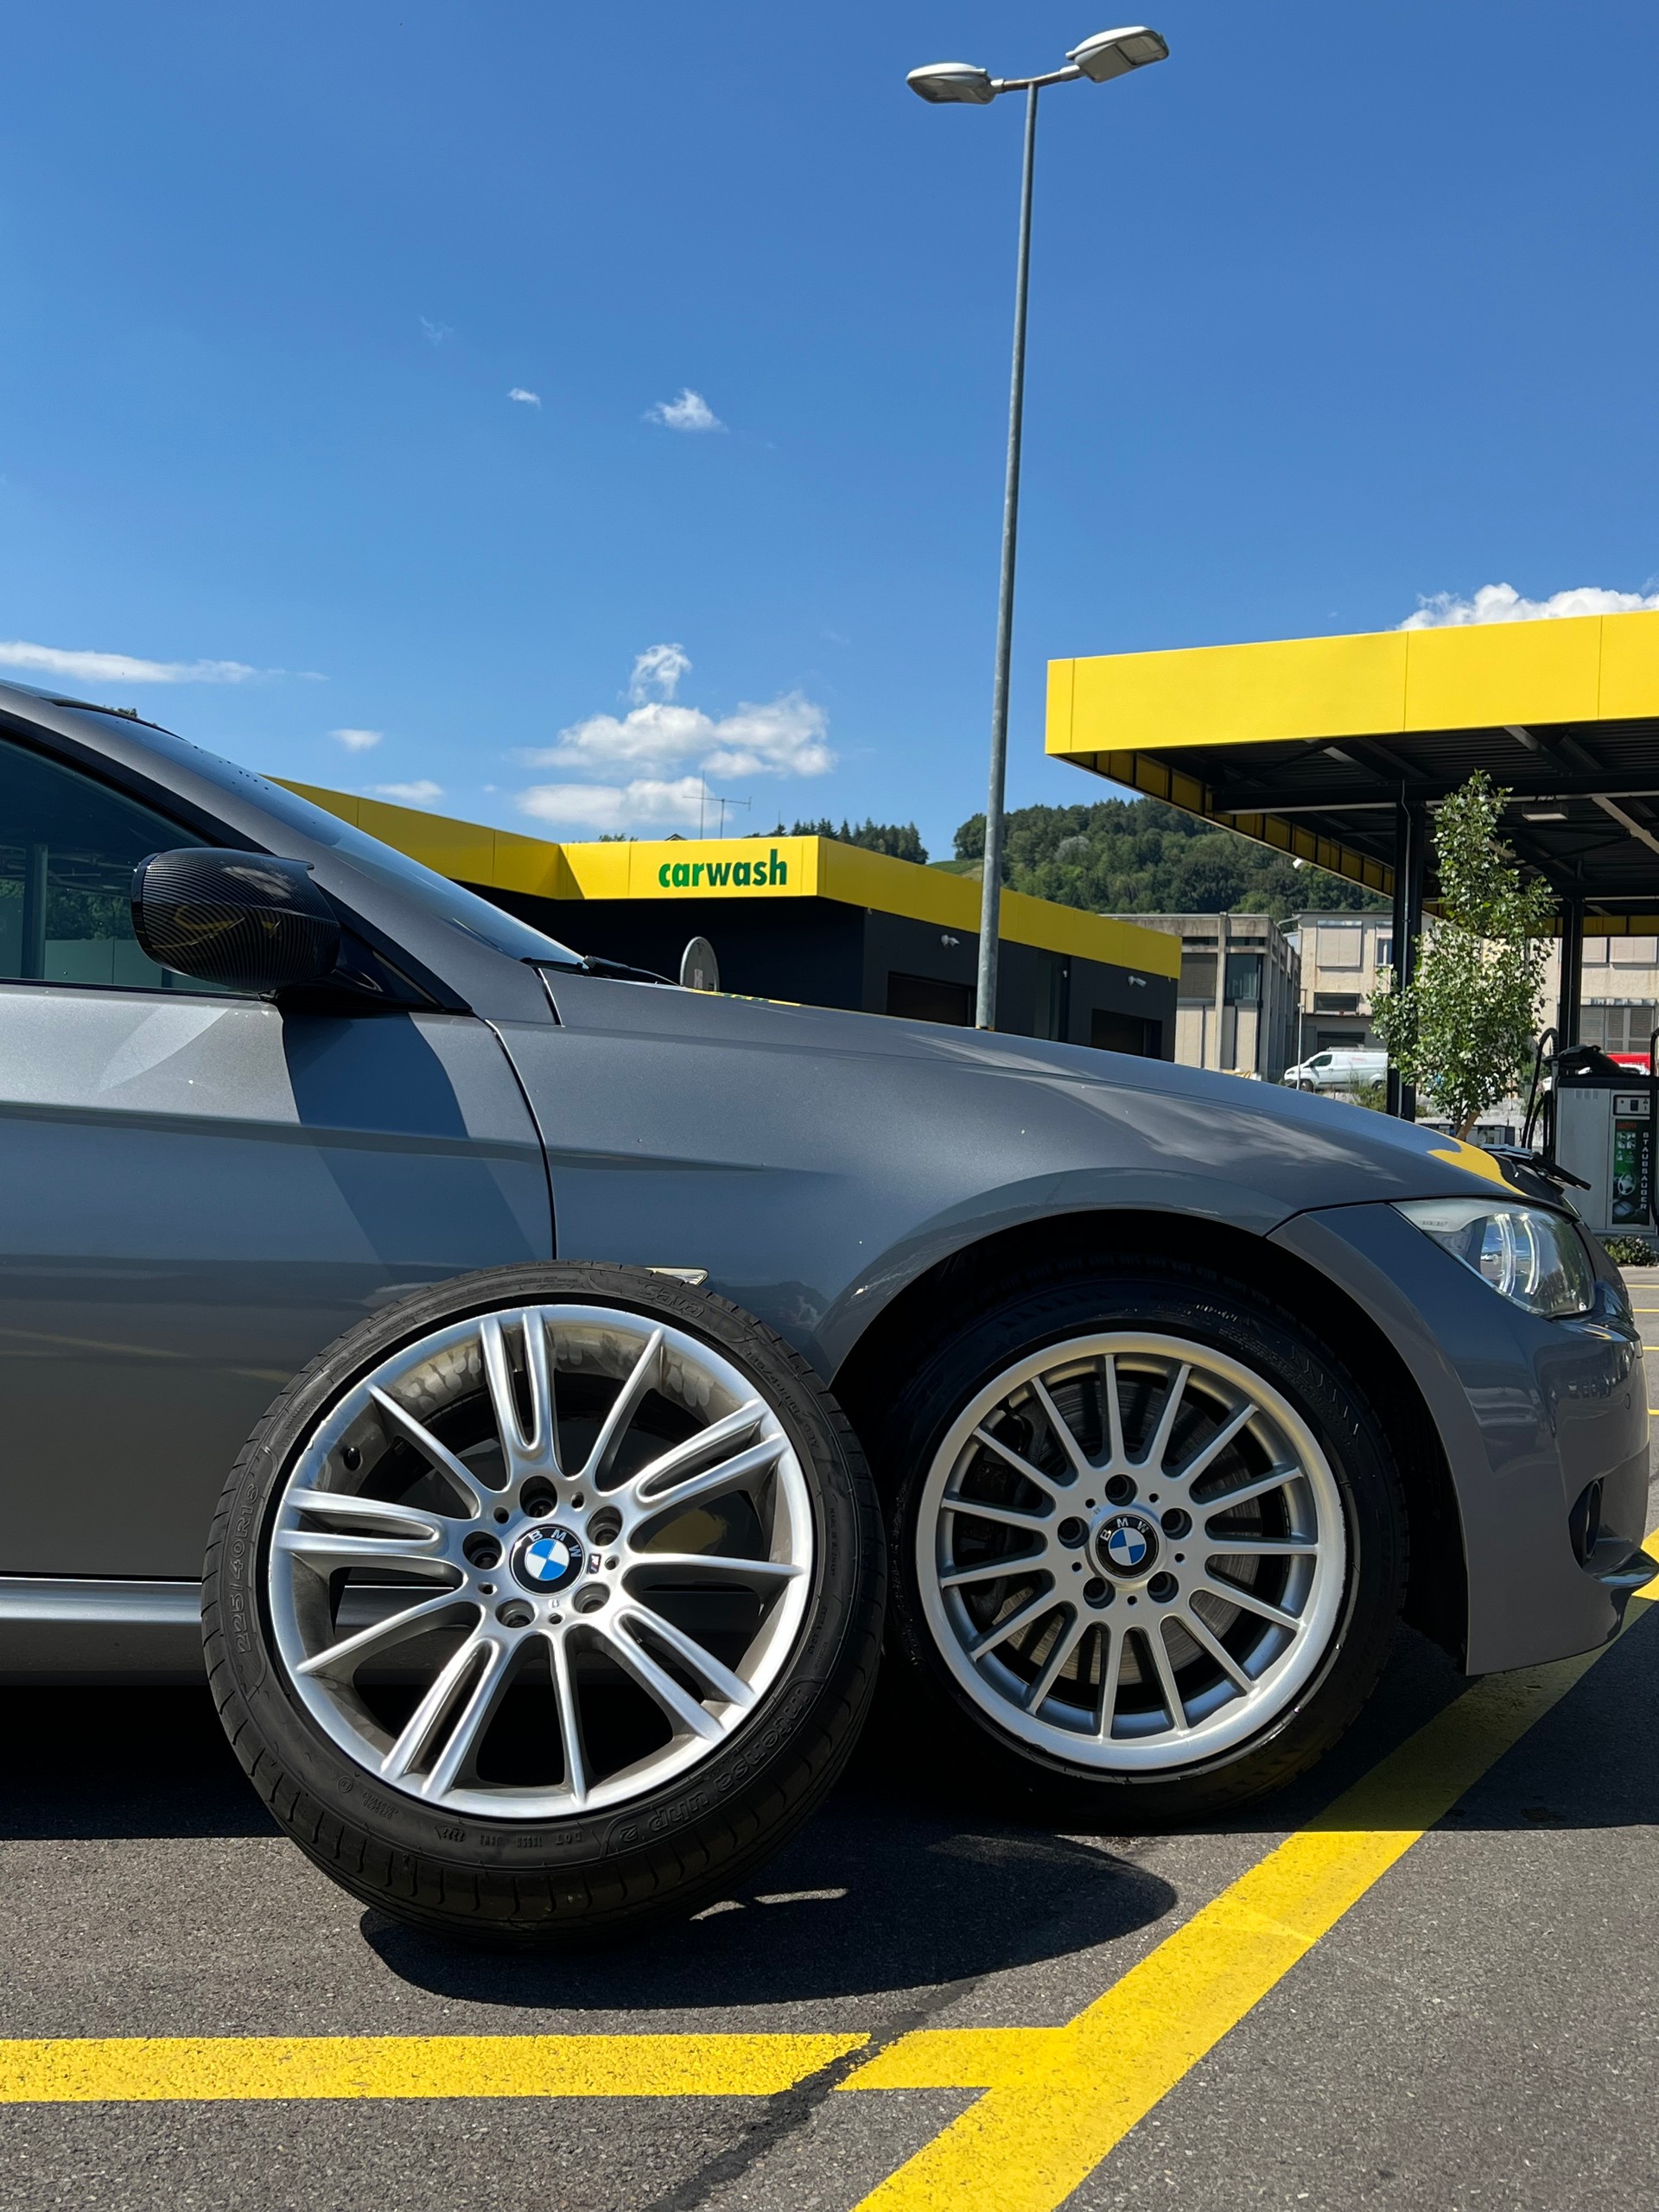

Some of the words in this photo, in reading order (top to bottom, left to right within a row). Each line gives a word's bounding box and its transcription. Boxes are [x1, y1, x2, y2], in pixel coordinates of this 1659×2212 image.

[658, 848, 787, 887] carwash
[640, 1283, 704, 1318] Sava
[528, 1529, 582, 1558] BMW
[1100, 1516, 1150, 1541] BMW
[227, 1483, 260, 1655] 225/40R18
[715, 1687, 810, 1793] intensa
[646, 1789, 709, 1834] uhp
[555, 1830, 582, 1846] DOT
[619, 1824, 639, 1842] 2
